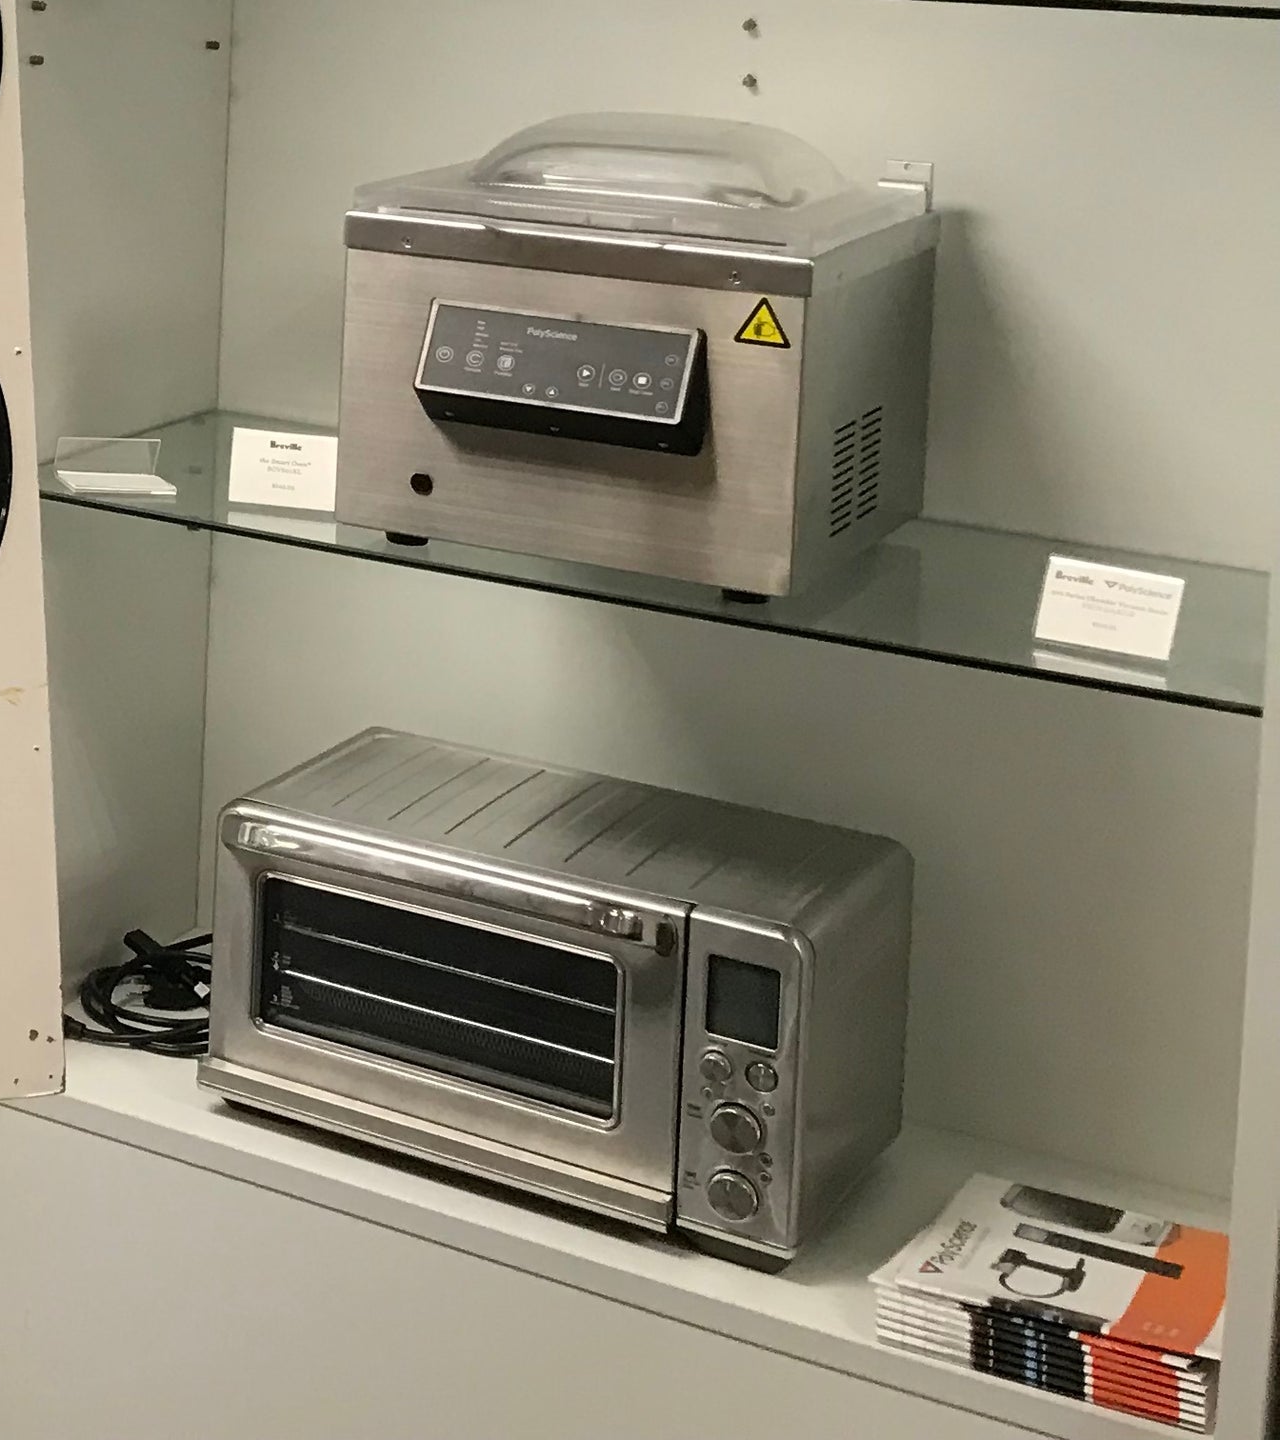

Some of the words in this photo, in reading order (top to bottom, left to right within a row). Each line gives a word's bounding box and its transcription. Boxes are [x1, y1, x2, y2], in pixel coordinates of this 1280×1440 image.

[526, 326, 578, 342] PolyScience
[270, 440, 302, 451] Breville
[1055, 570, 1094, 586] Breville
